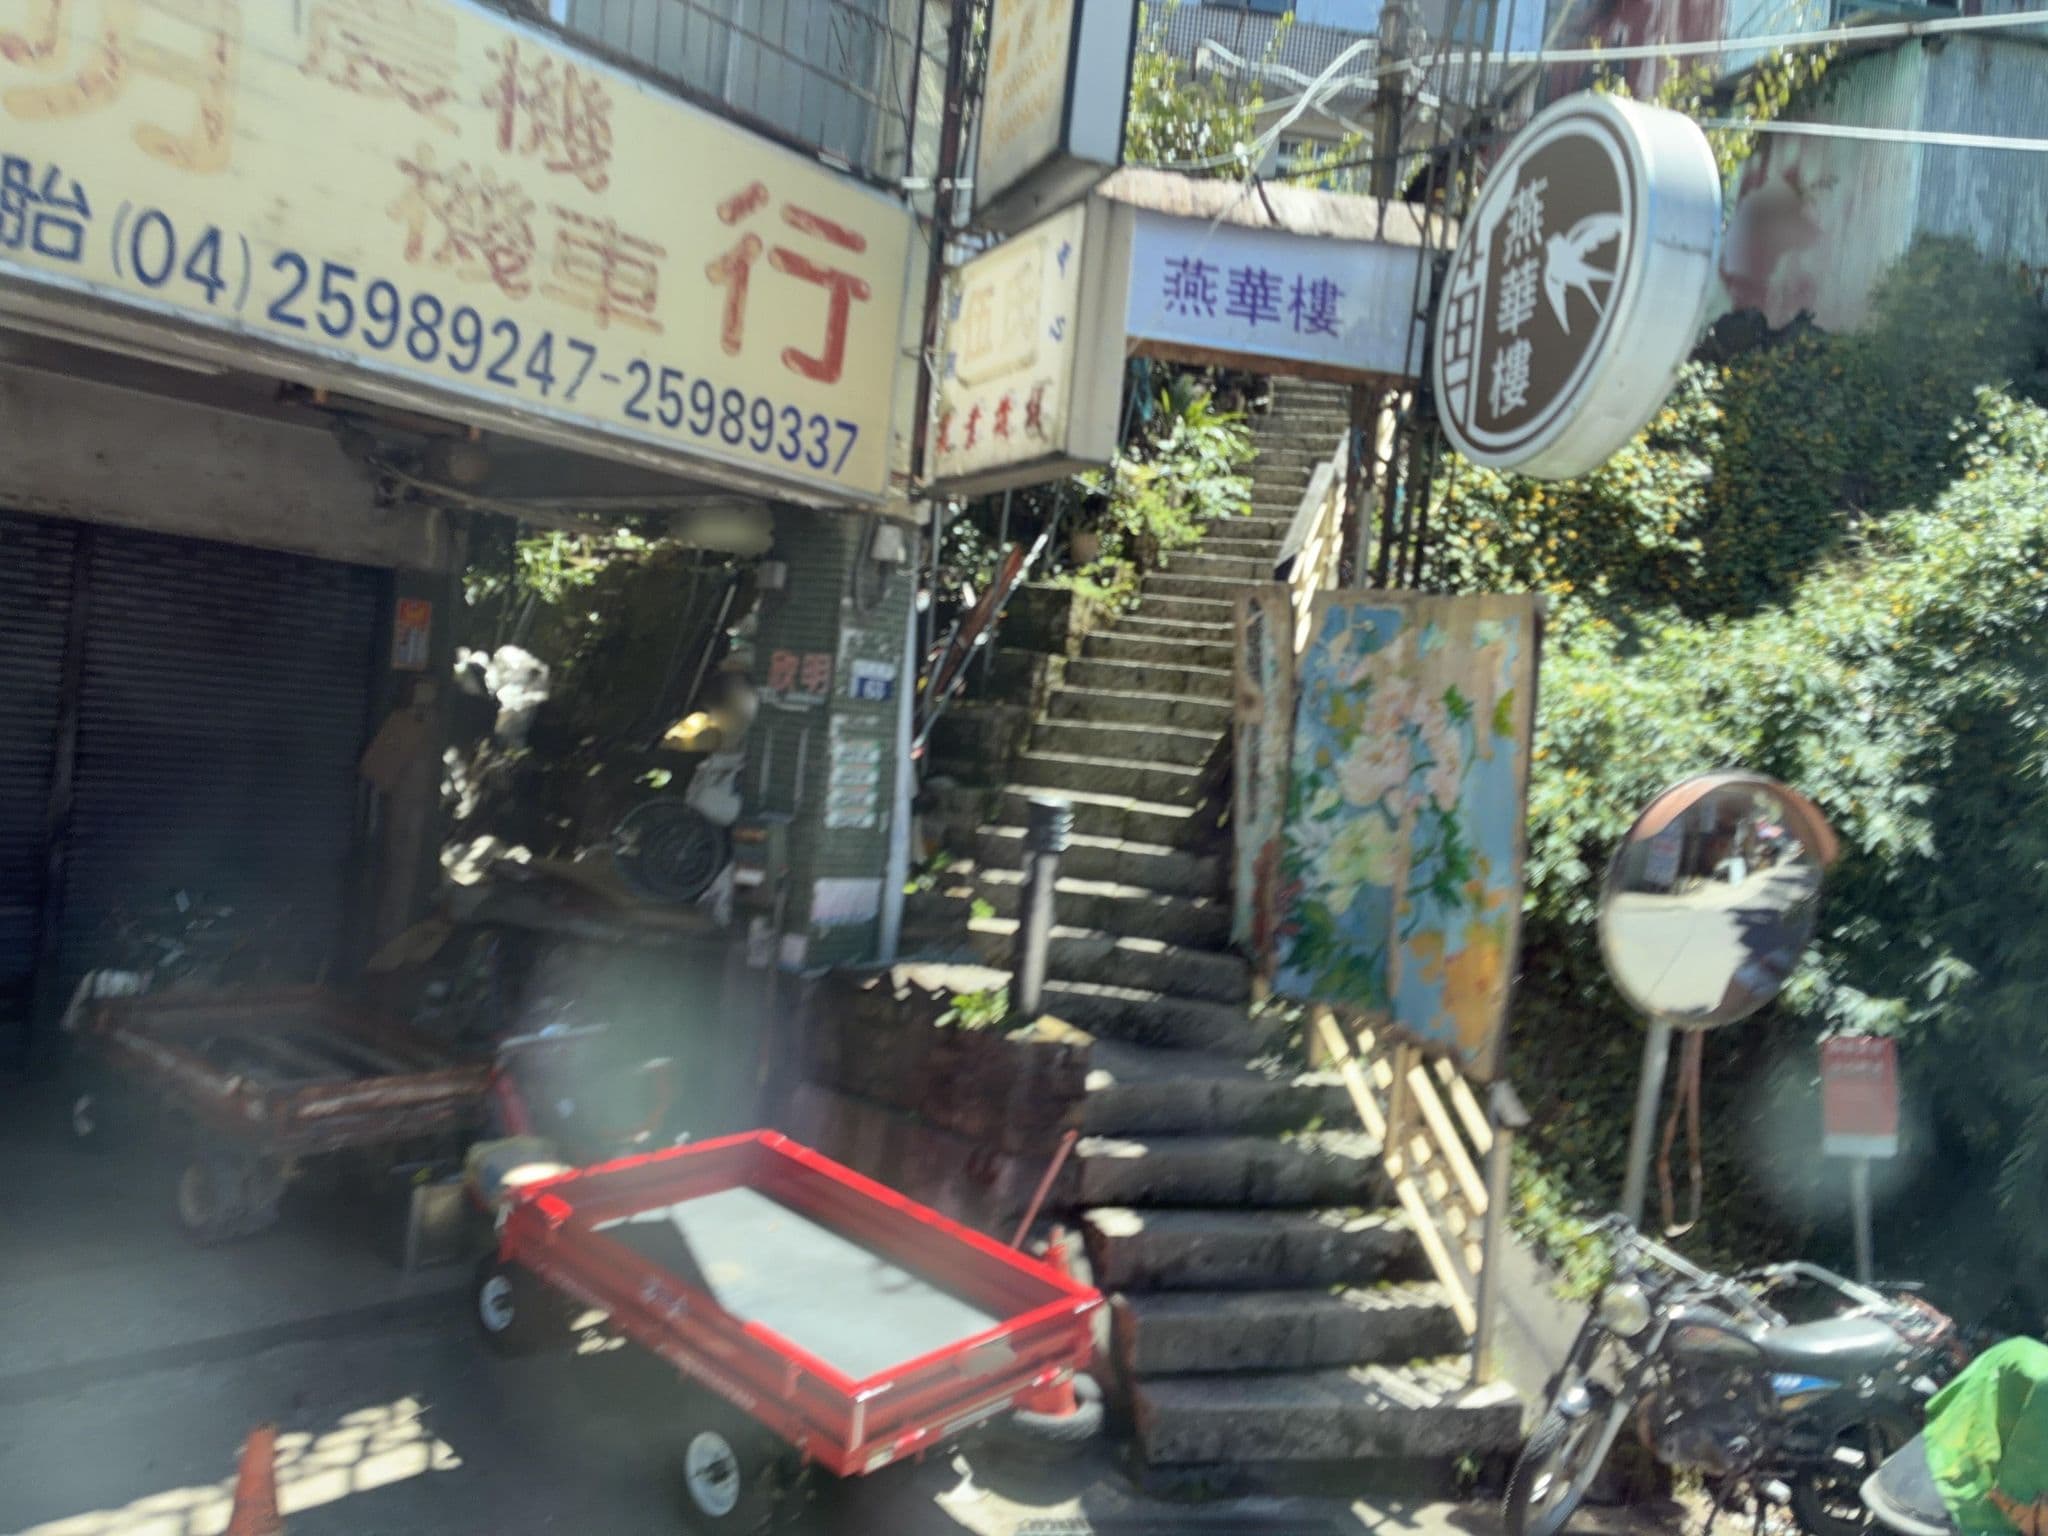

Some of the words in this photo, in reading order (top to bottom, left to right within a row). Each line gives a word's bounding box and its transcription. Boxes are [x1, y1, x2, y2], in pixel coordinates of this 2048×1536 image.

[706, 180, 871, 386] 行
[1162, 254, 1347, 340] 燕華樓
[1488, 176, 1550, 420] 燕華樓
